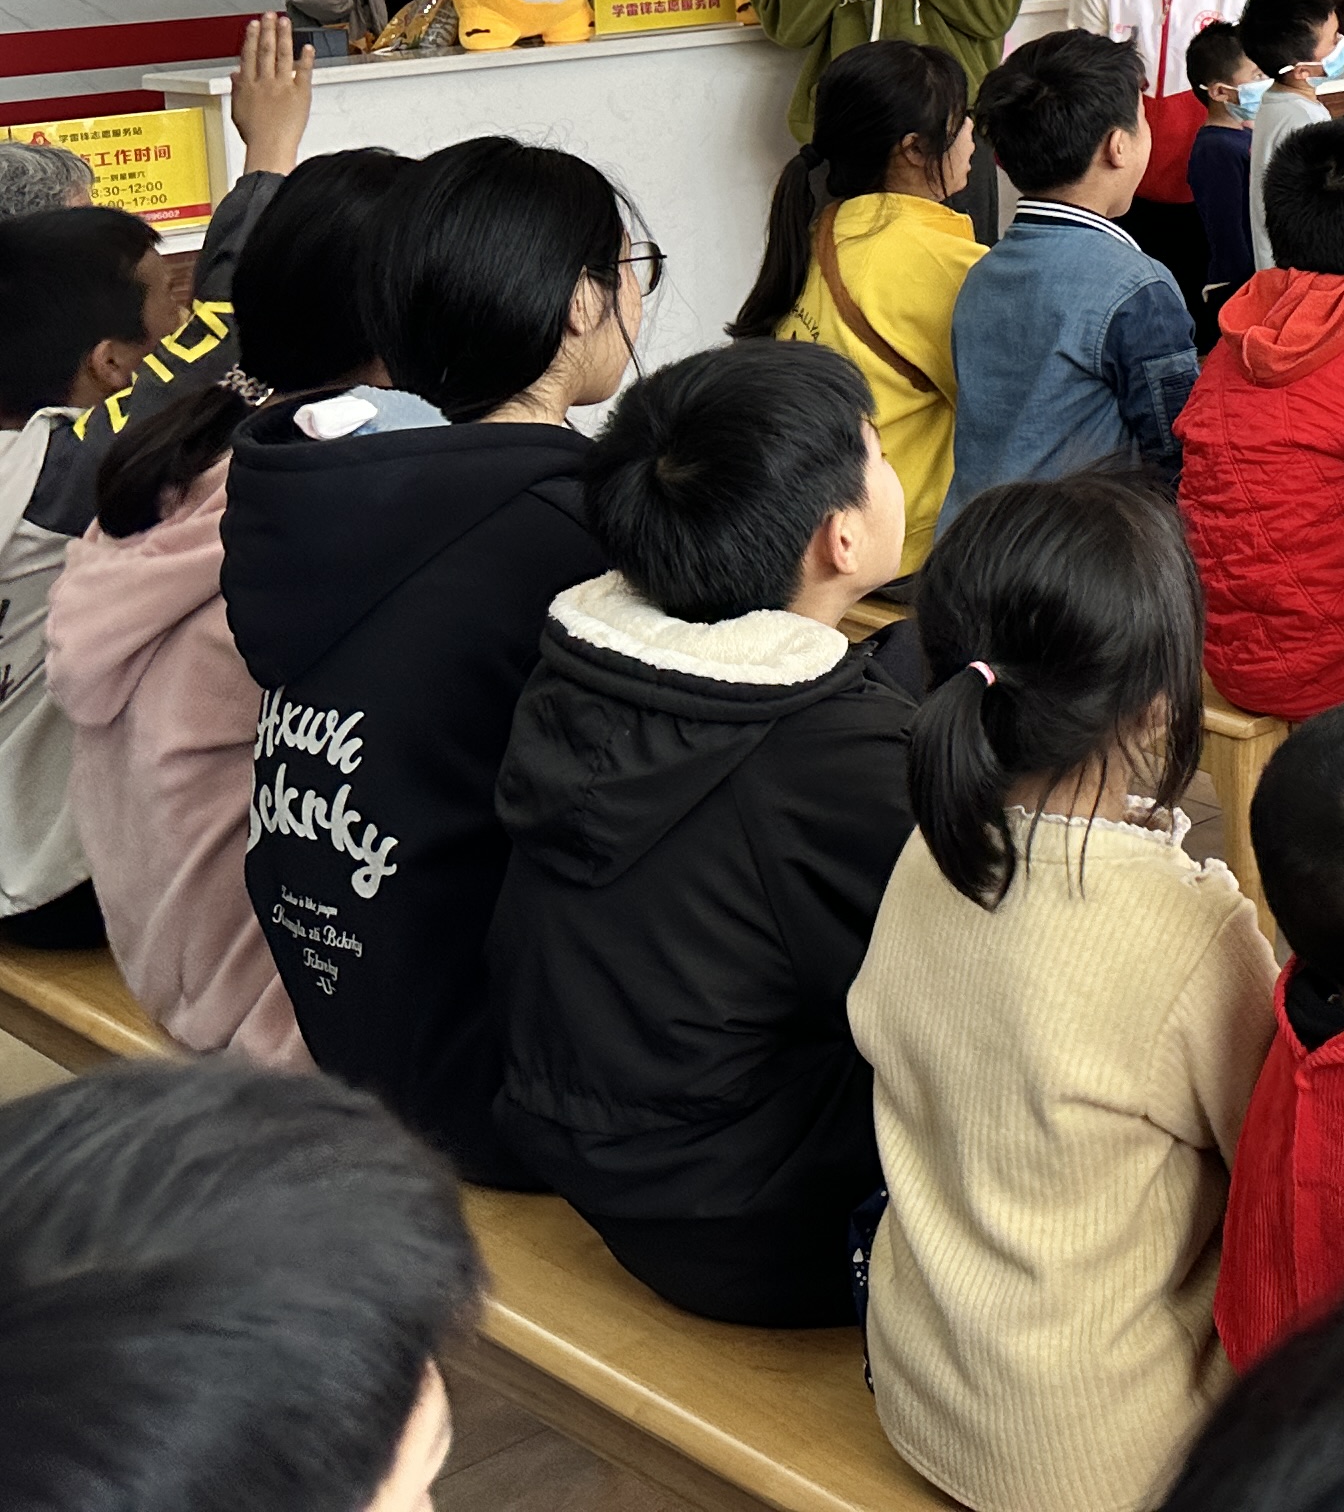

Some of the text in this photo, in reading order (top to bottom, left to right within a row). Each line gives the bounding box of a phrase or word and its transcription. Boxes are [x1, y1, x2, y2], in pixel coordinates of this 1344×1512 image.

[59, 126, 143, 143] 学雷锋志愿服务站
